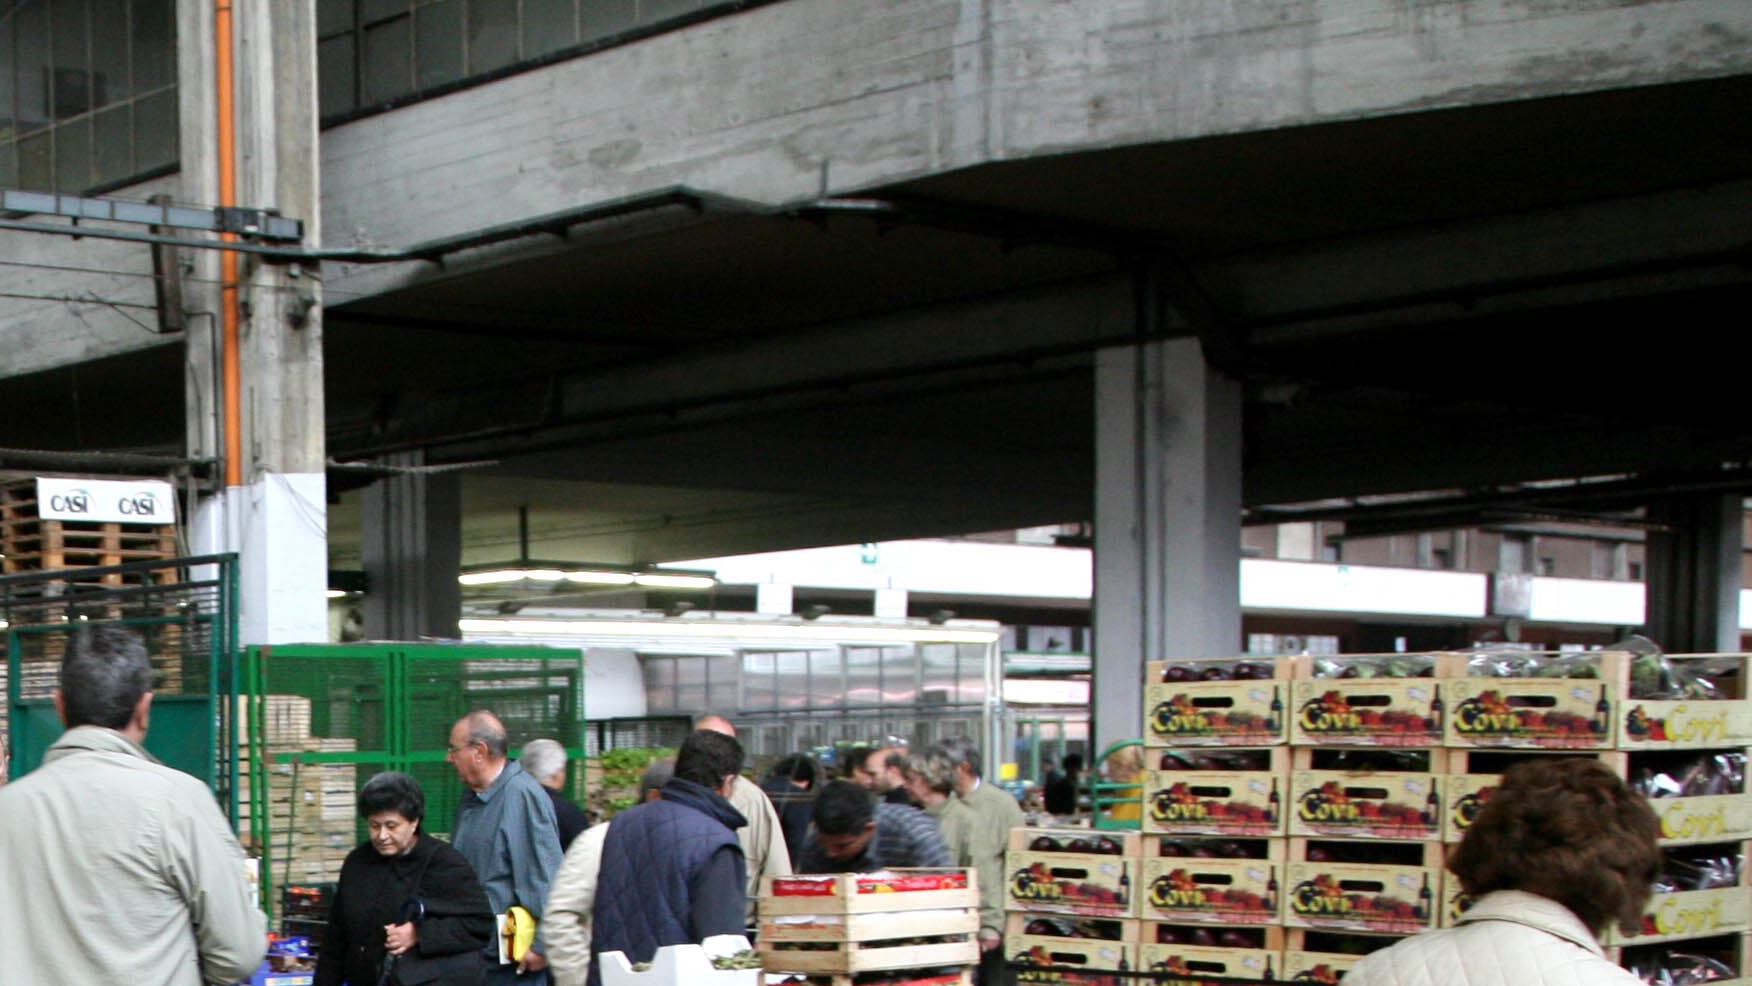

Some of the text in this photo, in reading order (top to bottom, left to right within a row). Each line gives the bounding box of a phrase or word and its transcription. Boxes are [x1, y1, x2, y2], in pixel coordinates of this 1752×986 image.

[1664, 704, 1728, 742] Covi
[1660, 800, 1727, 840] Covi
[1655, 898, 1722, 936] Covi
